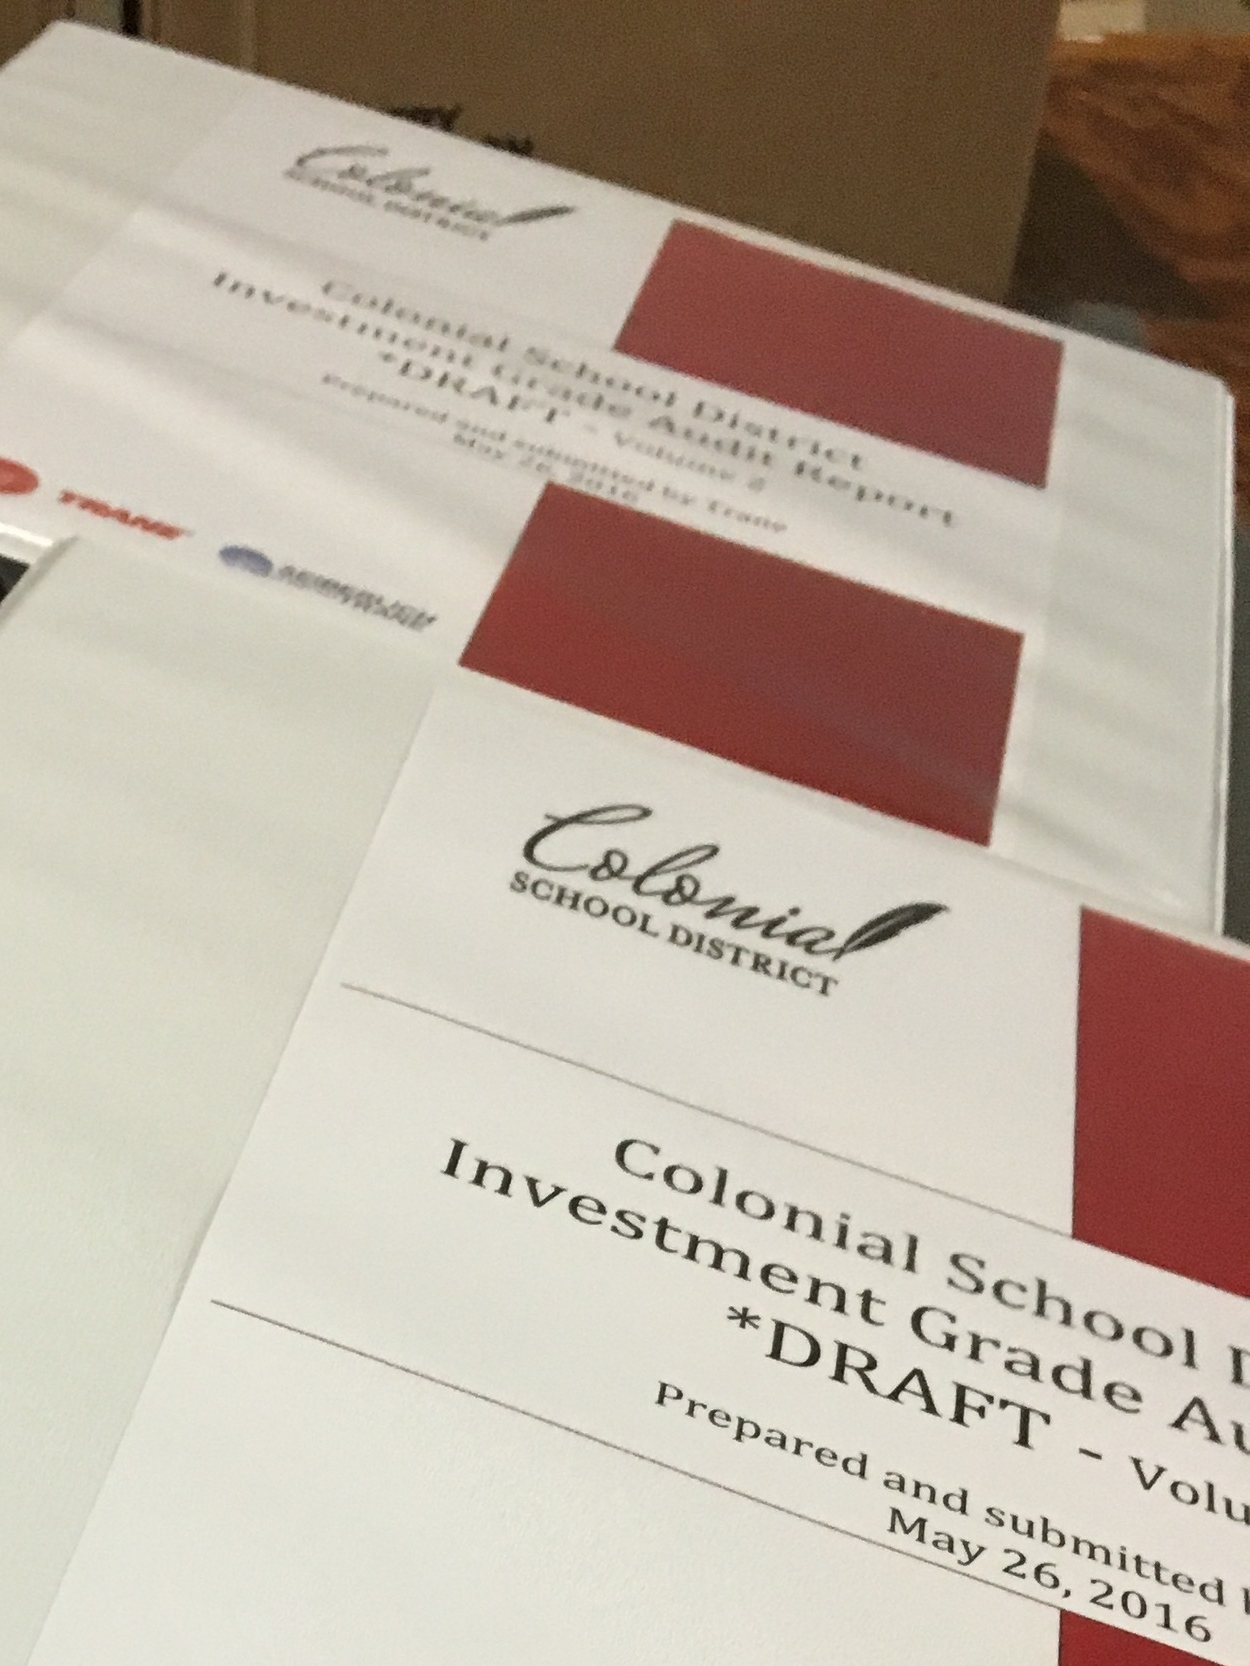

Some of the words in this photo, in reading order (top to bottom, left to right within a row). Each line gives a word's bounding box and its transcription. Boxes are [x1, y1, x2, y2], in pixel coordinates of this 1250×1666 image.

[213, 271, 474, 368] Investment
[491, 361, 633, 420] Grade
[648, 414, 773, 467] Audit
[795, 459, 953, 528] Report
[321, 280, 509, 352] Colonial
[524, 346, 678, 408] School
[693, 400, 863, 470] District
[508, 869, 660, 938] SCHOOL
[666, 920, 840, 998] DISTRICT
[521, 802, 951, 963] Colonial
[439, 1137, 890, 1328] Investment
[909, 1302, 1144, 1415] Grade
[613, 1136, 922, 1276] Colonial
[945, 1250, 1199, 1371] School
[654, 1379, 870, 1482] Prepared
[882, 1463, 971, 1518] and
[983, 1495, 1226, 1608] submitted
[887, 1505, 989, 1570] May
[1001, 1545, 1073, 1600] 26,
[1088, 1577, 1213, 1644] 2016
